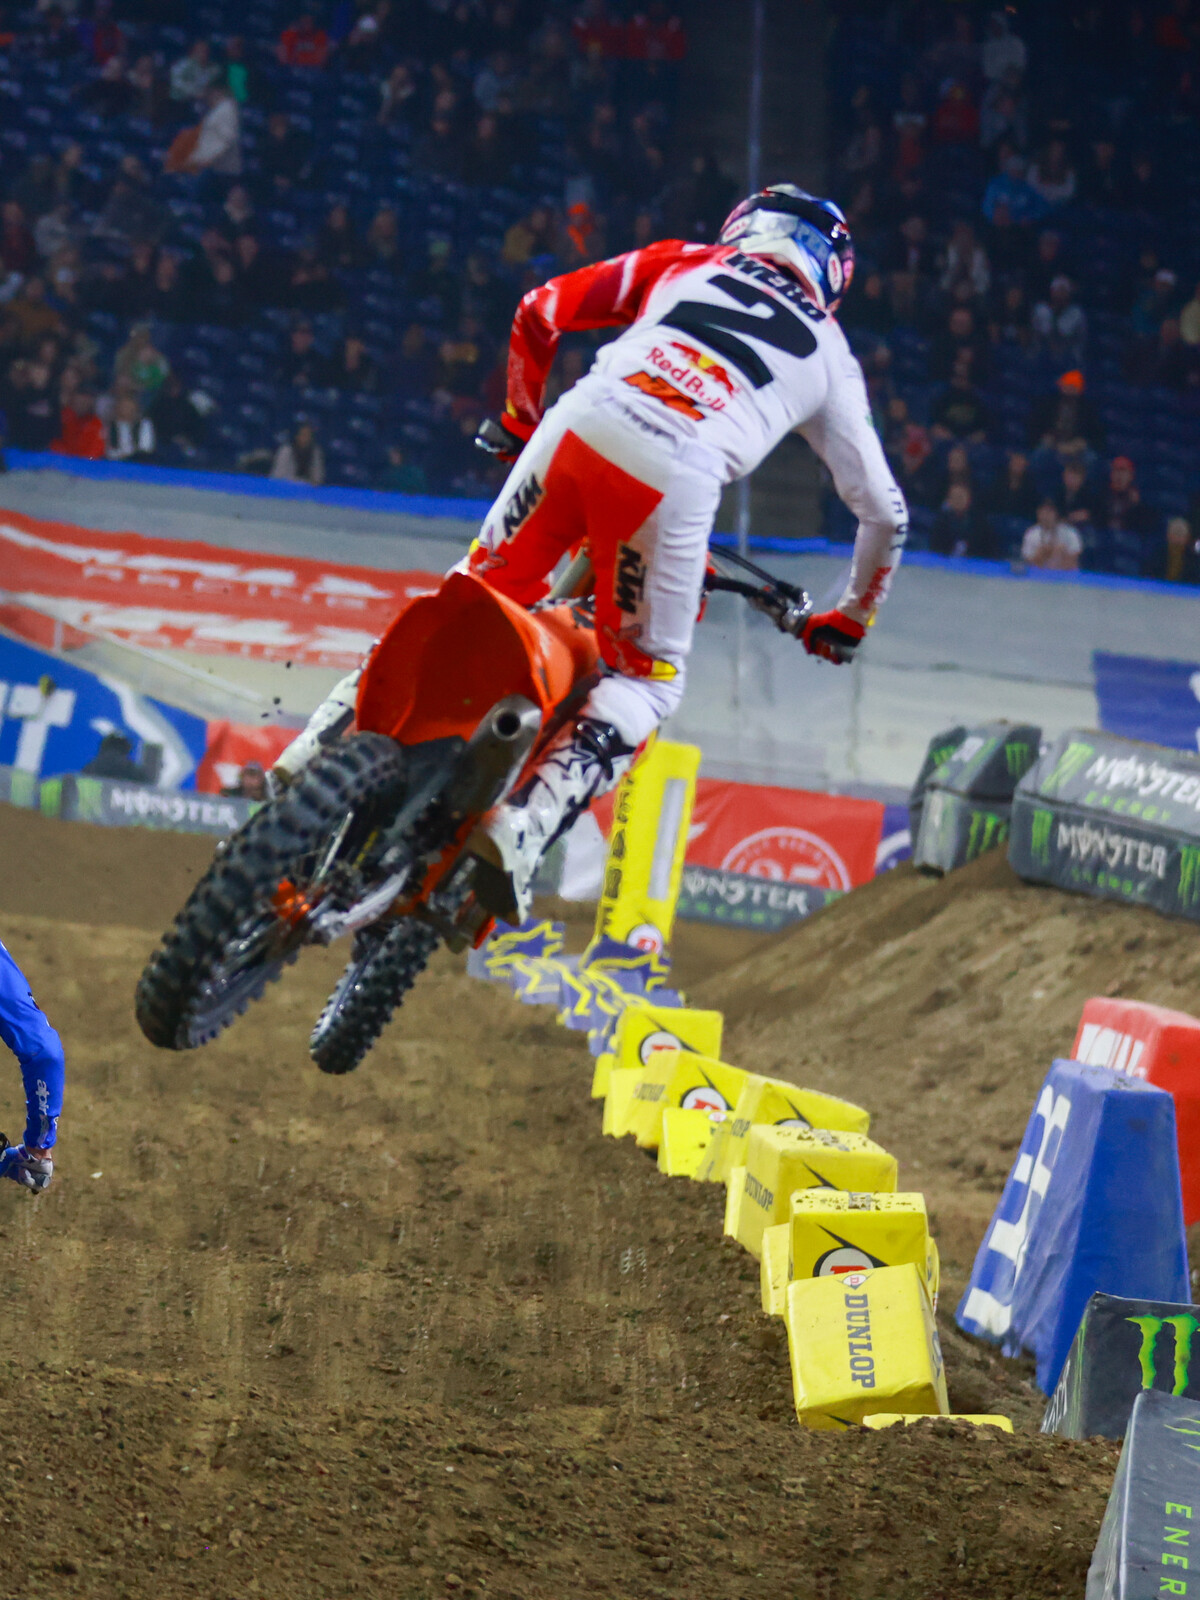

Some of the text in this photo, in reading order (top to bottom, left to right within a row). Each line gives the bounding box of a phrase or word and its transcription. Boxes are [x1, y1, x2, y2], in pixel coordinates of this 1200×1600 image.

[657, 273, 818, 390] 2
[645, 347, 691, 383] Red
[503, 472, 543, 539] KTM
[614, 543, 648, 615] KTM
[110, 788, 238, 829] MONSTER
[1085, 755, 1200, 812] MONSTE
[1057, 820, 1167, 880] MONSTER
[683, 868, 810, 916] ONSTER
[744, 1172, 775, 1213] DUNLOP
[844, 1293, 877, 1389] DUNLOP
[1159, 1501, 1193, 1596] ENER
